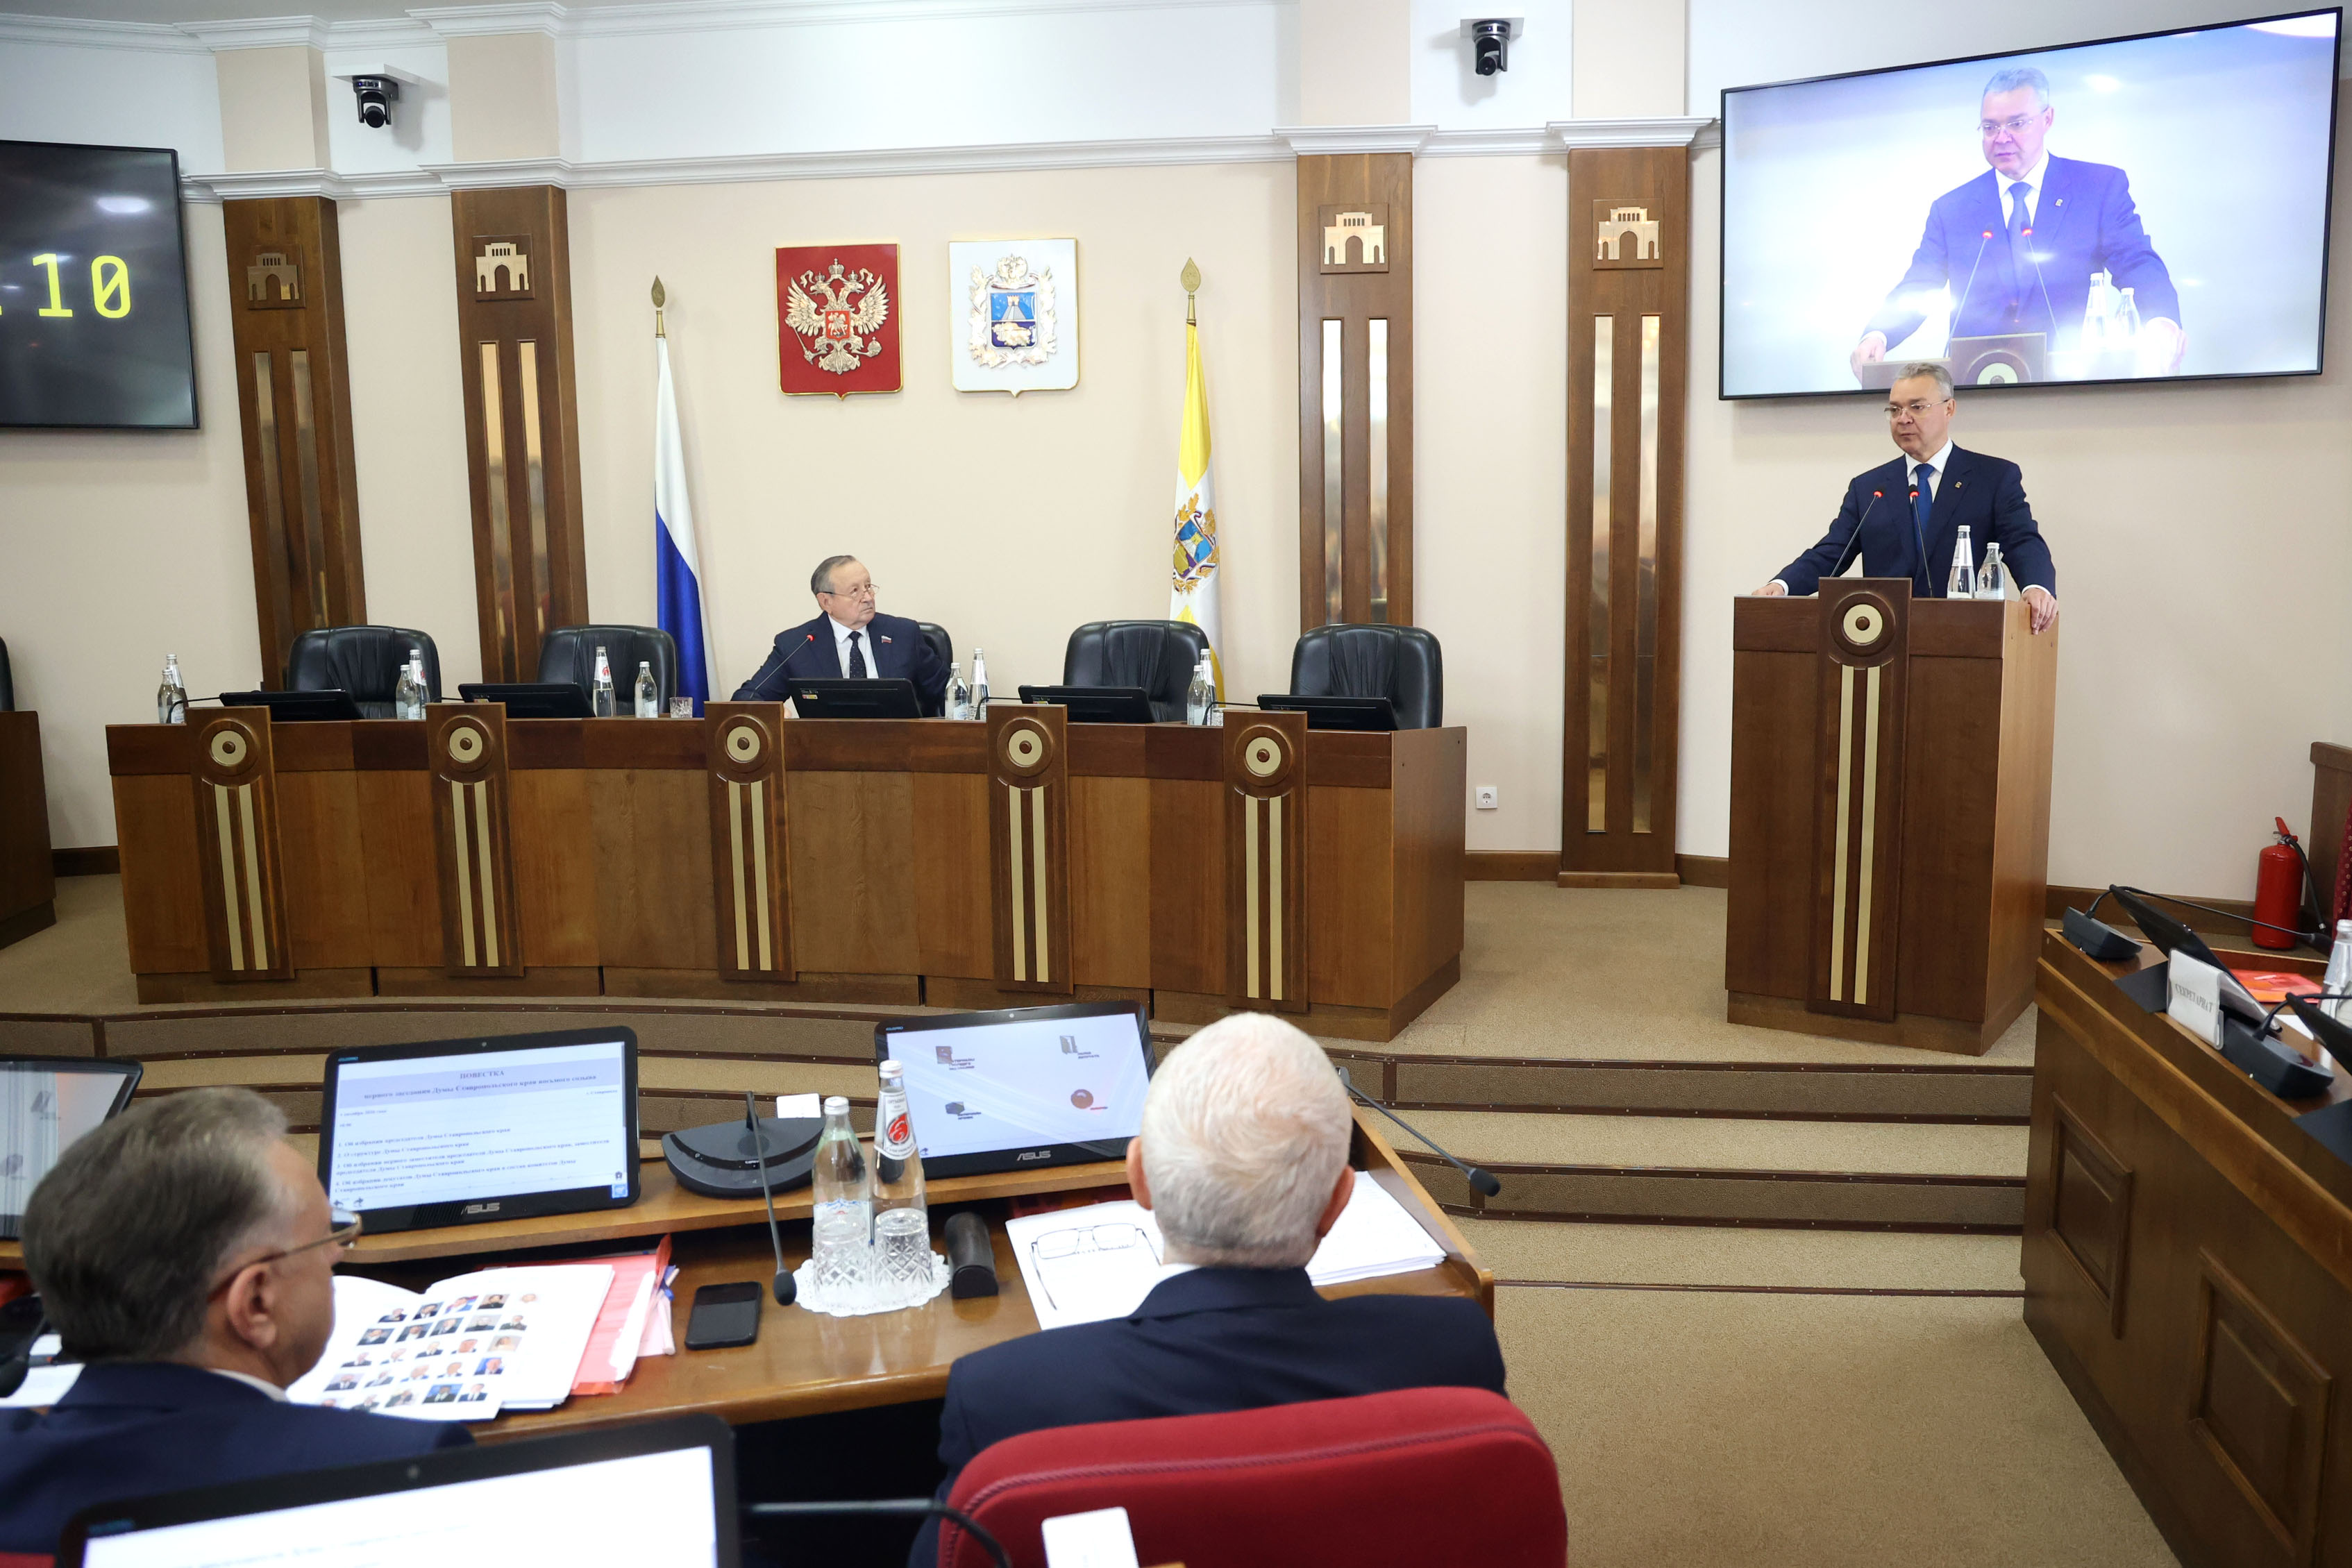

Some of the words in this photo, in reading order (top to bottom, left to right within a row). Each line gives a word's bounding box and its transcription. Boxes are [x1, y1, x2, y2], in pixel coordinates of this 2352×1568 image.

[0, 253, 131, 319] 10
[460, 1070, 504, 1079] ПОВЕСТКА
[1016, 1150, 1051, 1161] ASUS
[460, 1202, 500, 1215] ASUS
